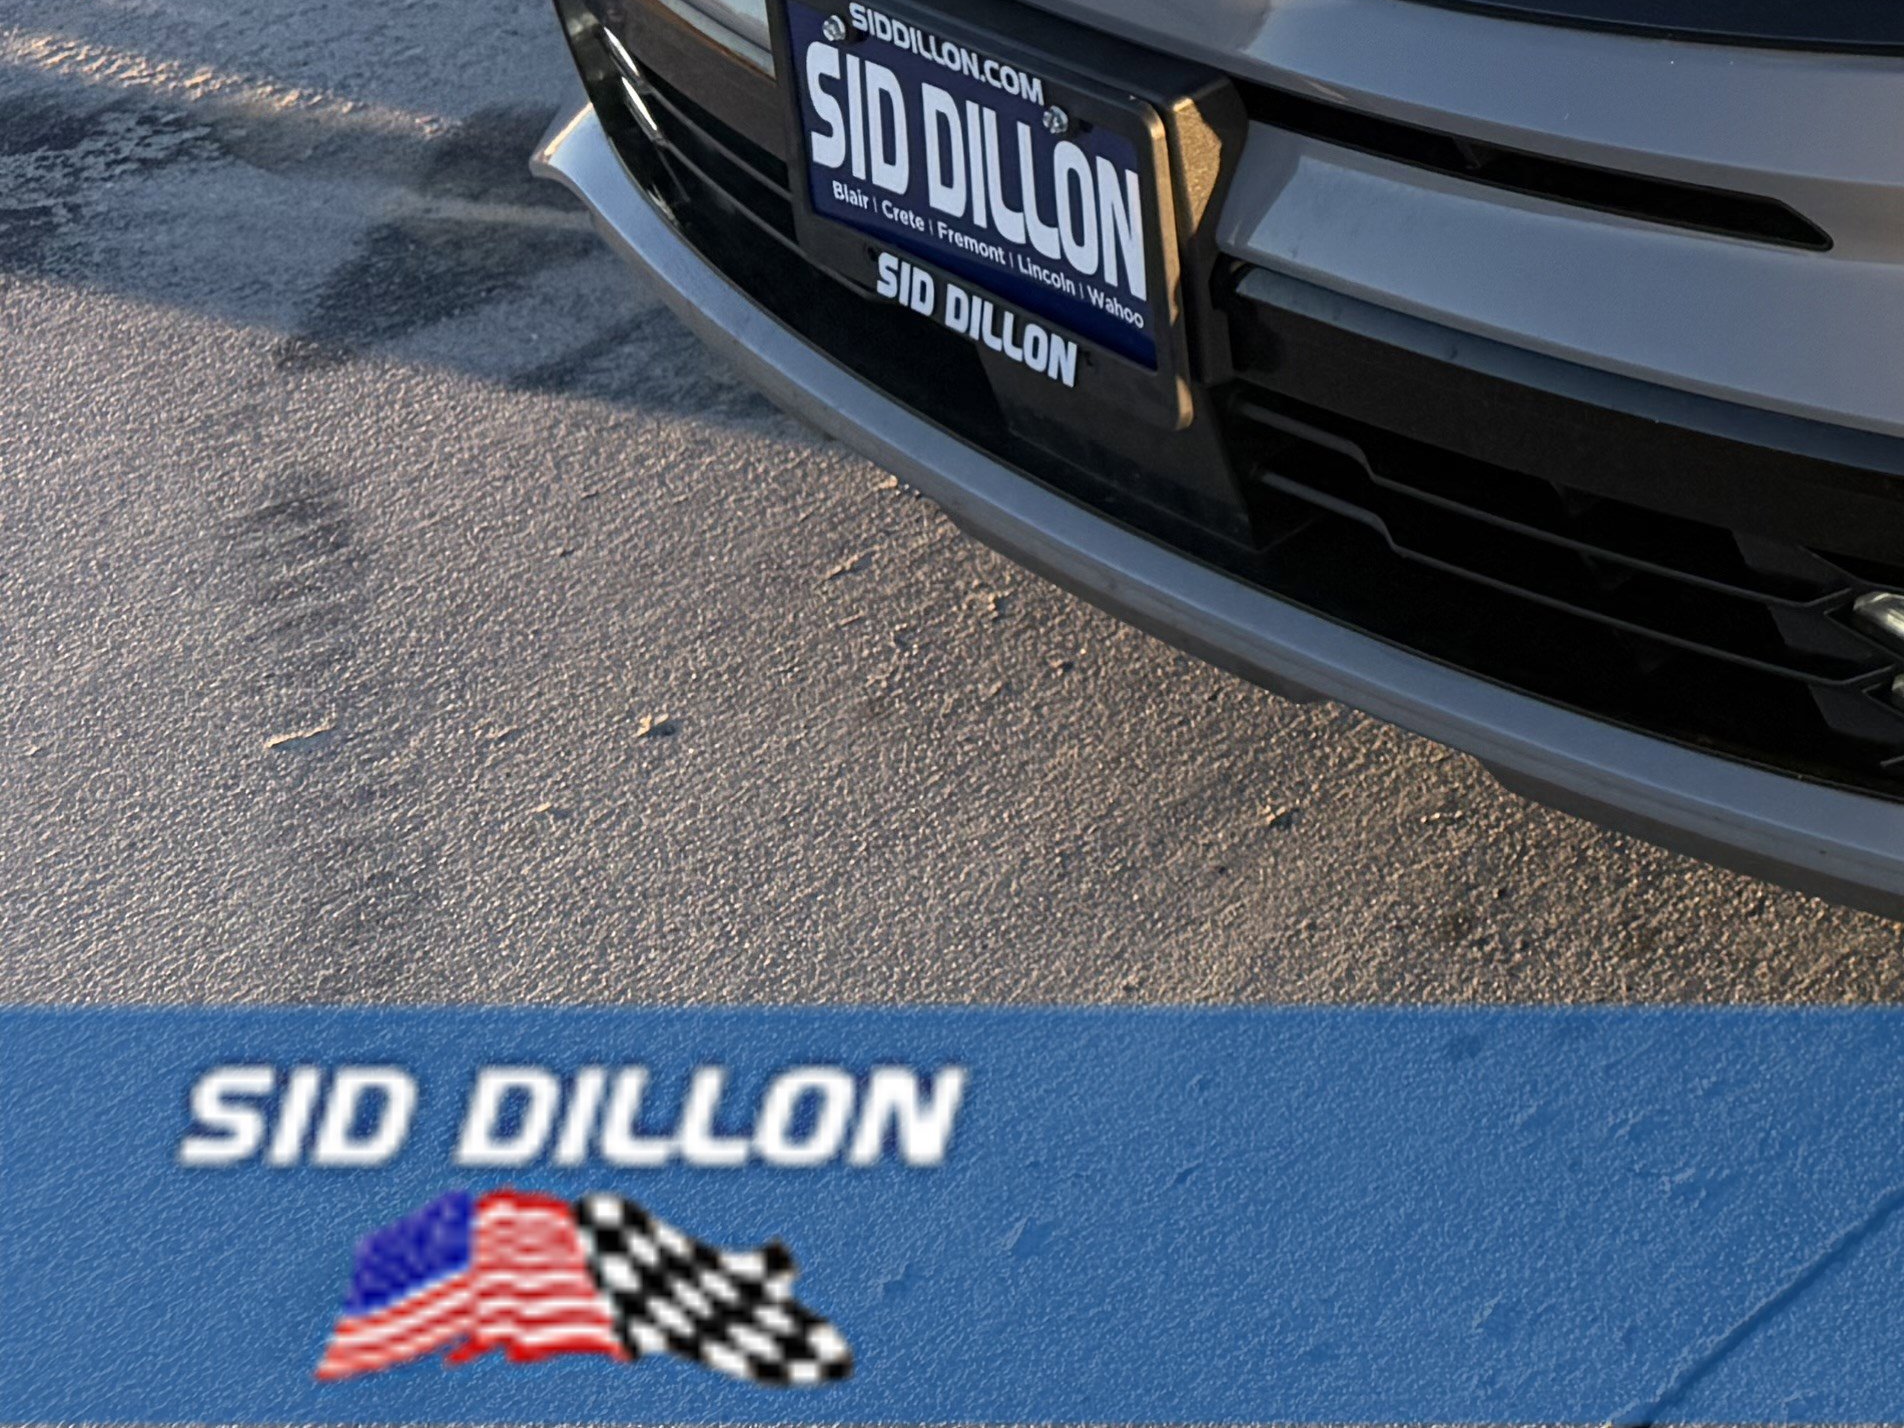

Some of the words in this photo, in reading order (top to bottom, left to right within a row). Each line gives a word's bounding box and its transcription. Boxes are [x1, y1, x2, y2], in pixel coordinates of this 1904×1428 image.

[849, 3, 1044, 106] SIDDILLON.COM
[806, 41, 910, 195] SID
[921, 82, 1147, 301] DILLON
[832, 181, 869, 210] Blair
[882, 199, 925, 233] Crete
[938, 222, 1006, 265] Fremont
[1018, 257, 1076, 297] Lincoln
[1088, 286, 1144, 329] Wahoo
[876, 252, 934, 317] SID
[944, 288, 1077, 388] DILLON
